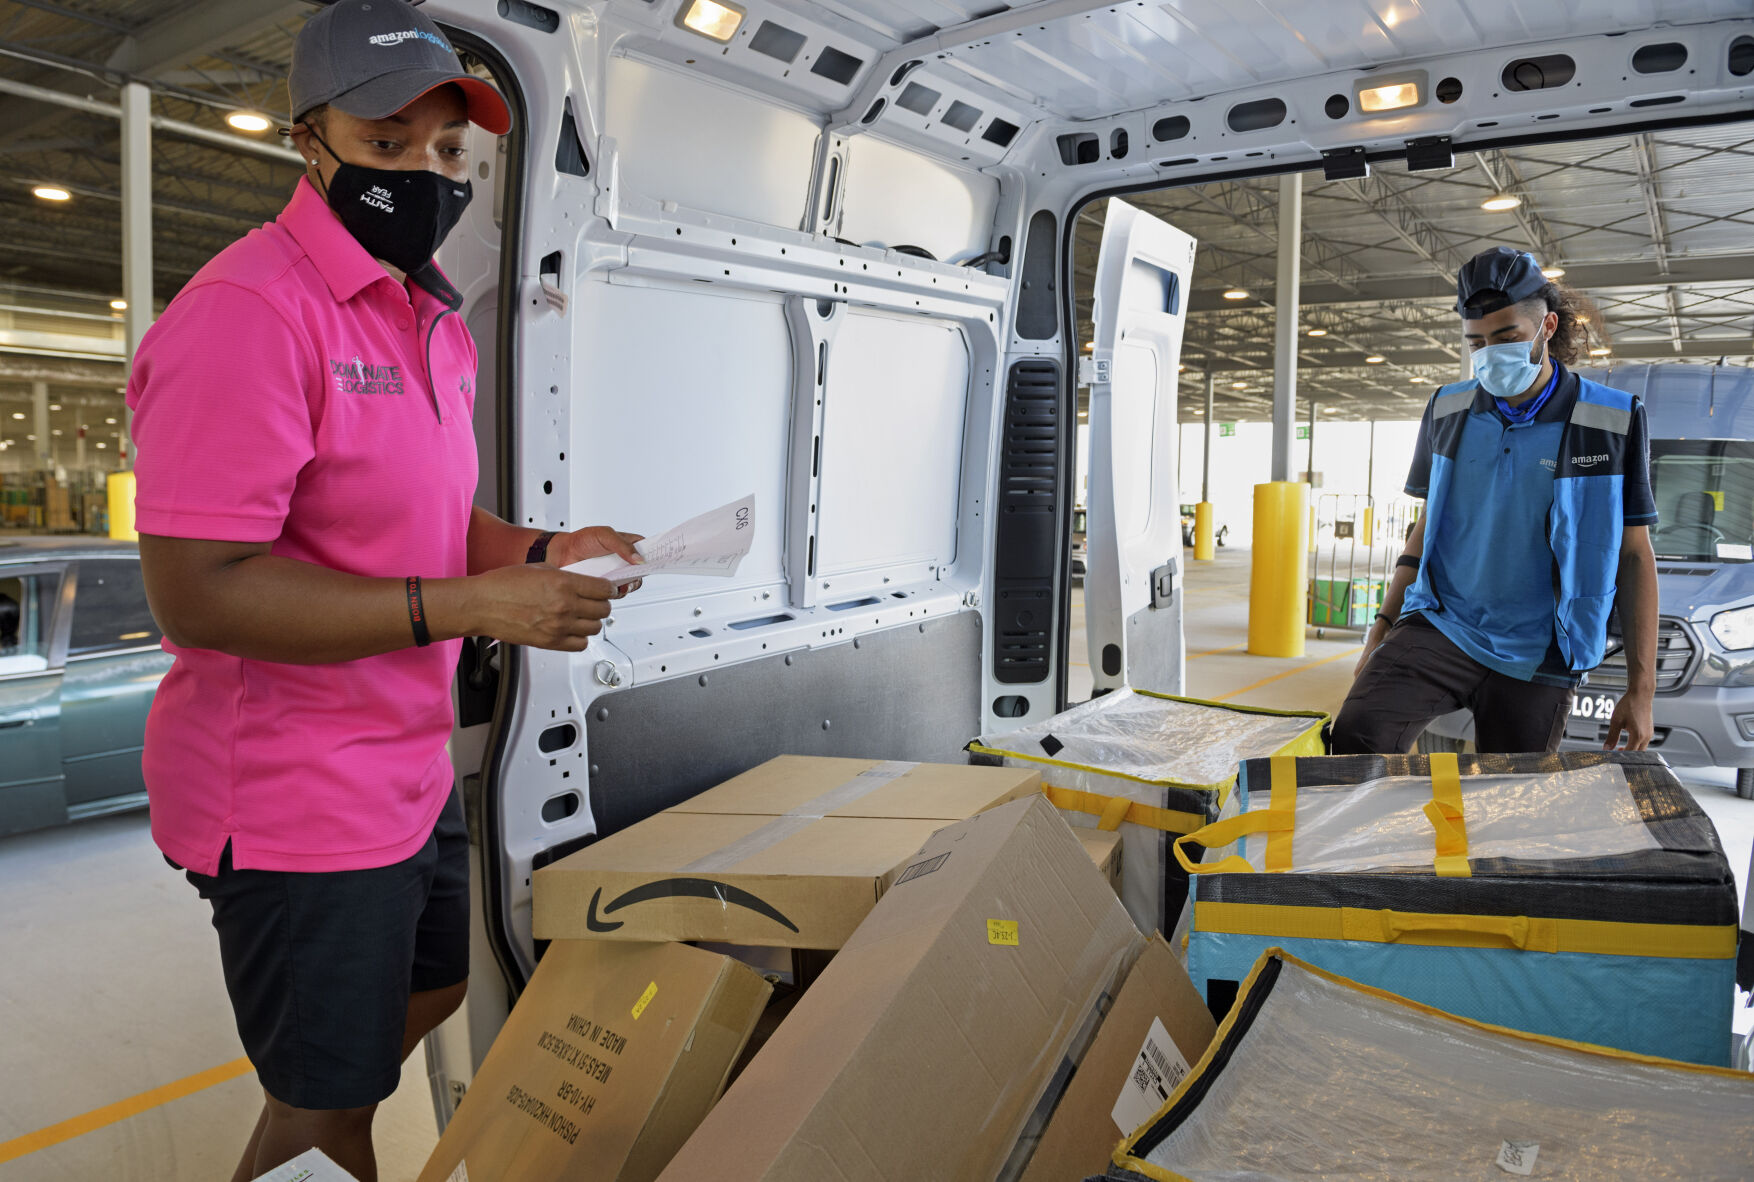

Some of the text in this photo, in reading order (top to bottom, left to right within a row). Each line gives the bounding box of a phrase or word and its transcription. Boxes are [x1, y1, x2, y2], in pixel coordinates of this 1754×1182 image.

[369, 30, 418, 46] amazon
[361, 194, 394, 213] FAITH
[371, 185, 392, 199] FEAR
[330, 357, 402, 381] DOMINATE
[1540, 458, 1557, 471] ama
[1571, 453, 1609, 467] amazon
[735, 507, 749, 530] CX6
[409, 583, 417, 594] TO
[410, 596, 421, 622] BORN
[1570, 695, 1615, 720] LO 29
[566, 1013, 627, 1056] MADE IN CHINA
[557, 1080, 596, 1116] HY-10-BR
[548, 1111, 581, 1145] PISHON
